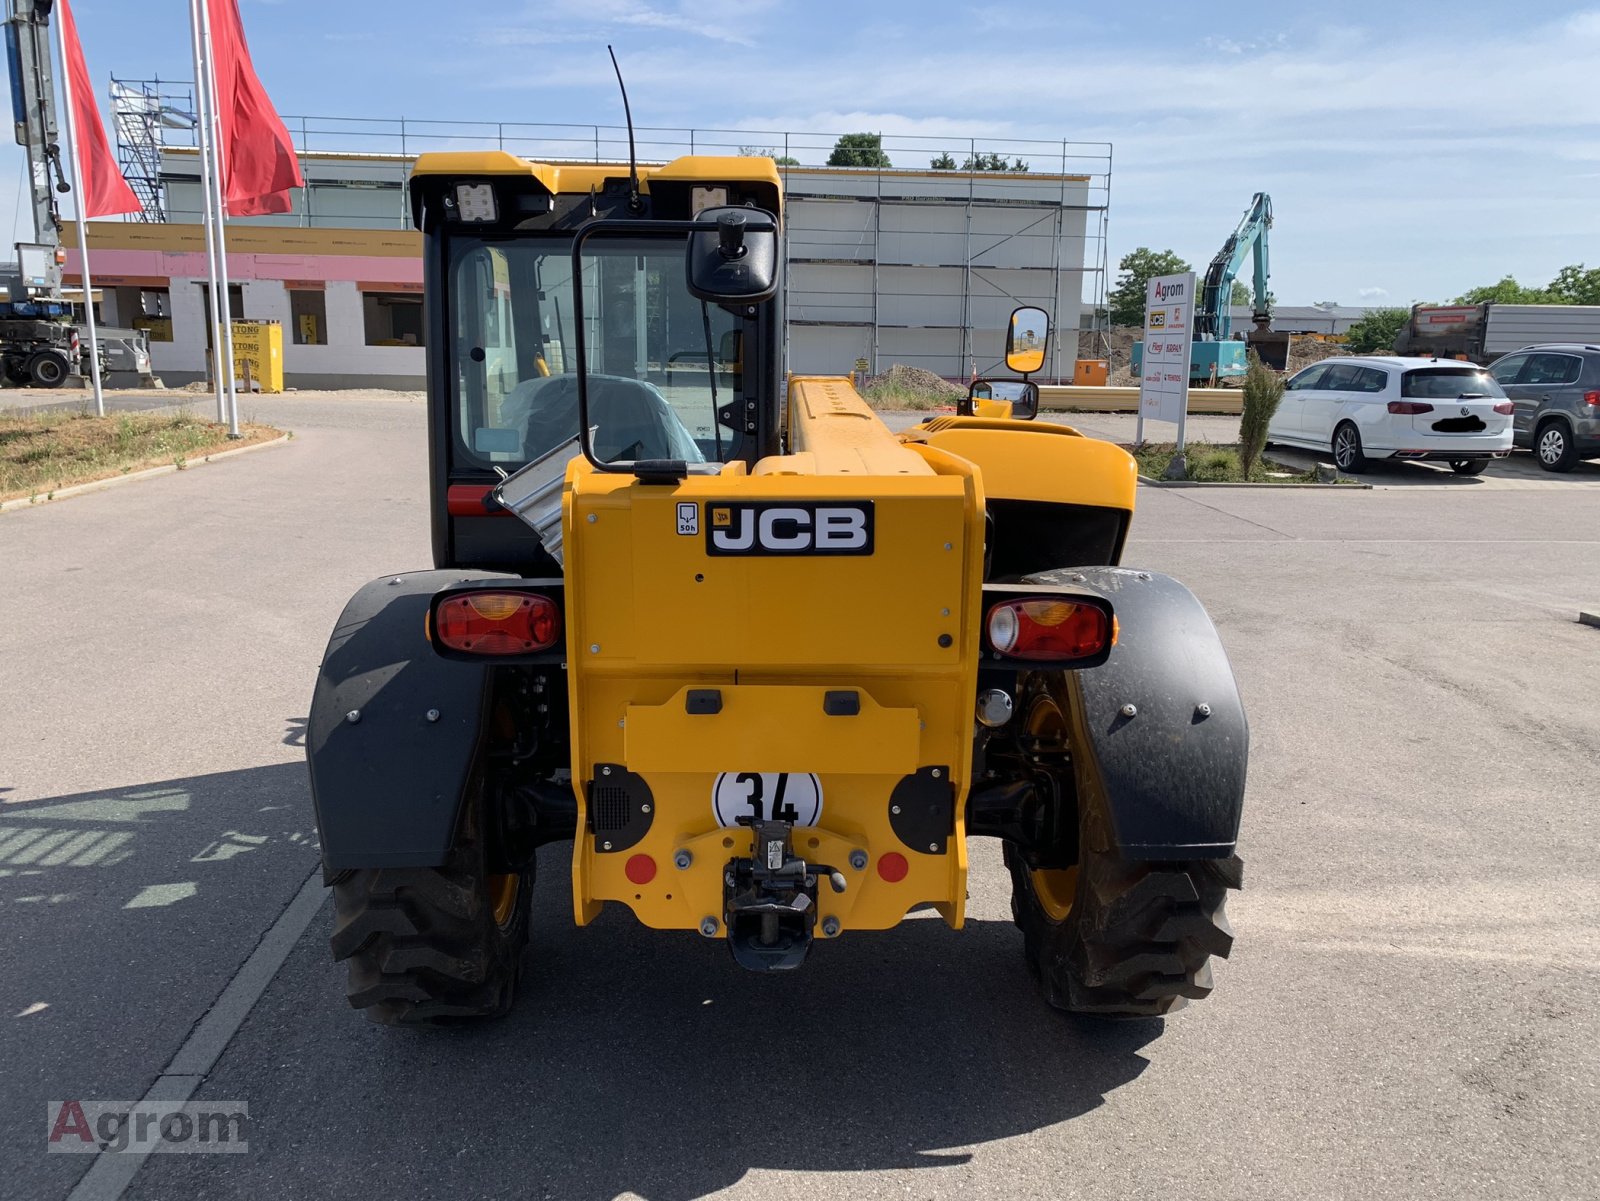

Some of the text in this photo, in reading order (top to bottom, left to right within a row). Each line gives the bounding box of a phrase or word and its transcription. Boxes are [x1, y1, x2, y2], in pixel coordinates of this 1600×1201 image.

[1155, 282, 1184, 301] Agrom
[1150, 314, 1164, 326] JCB
[713, 508, 868, 550] JCB
[735, 772, 799, 827] 34
